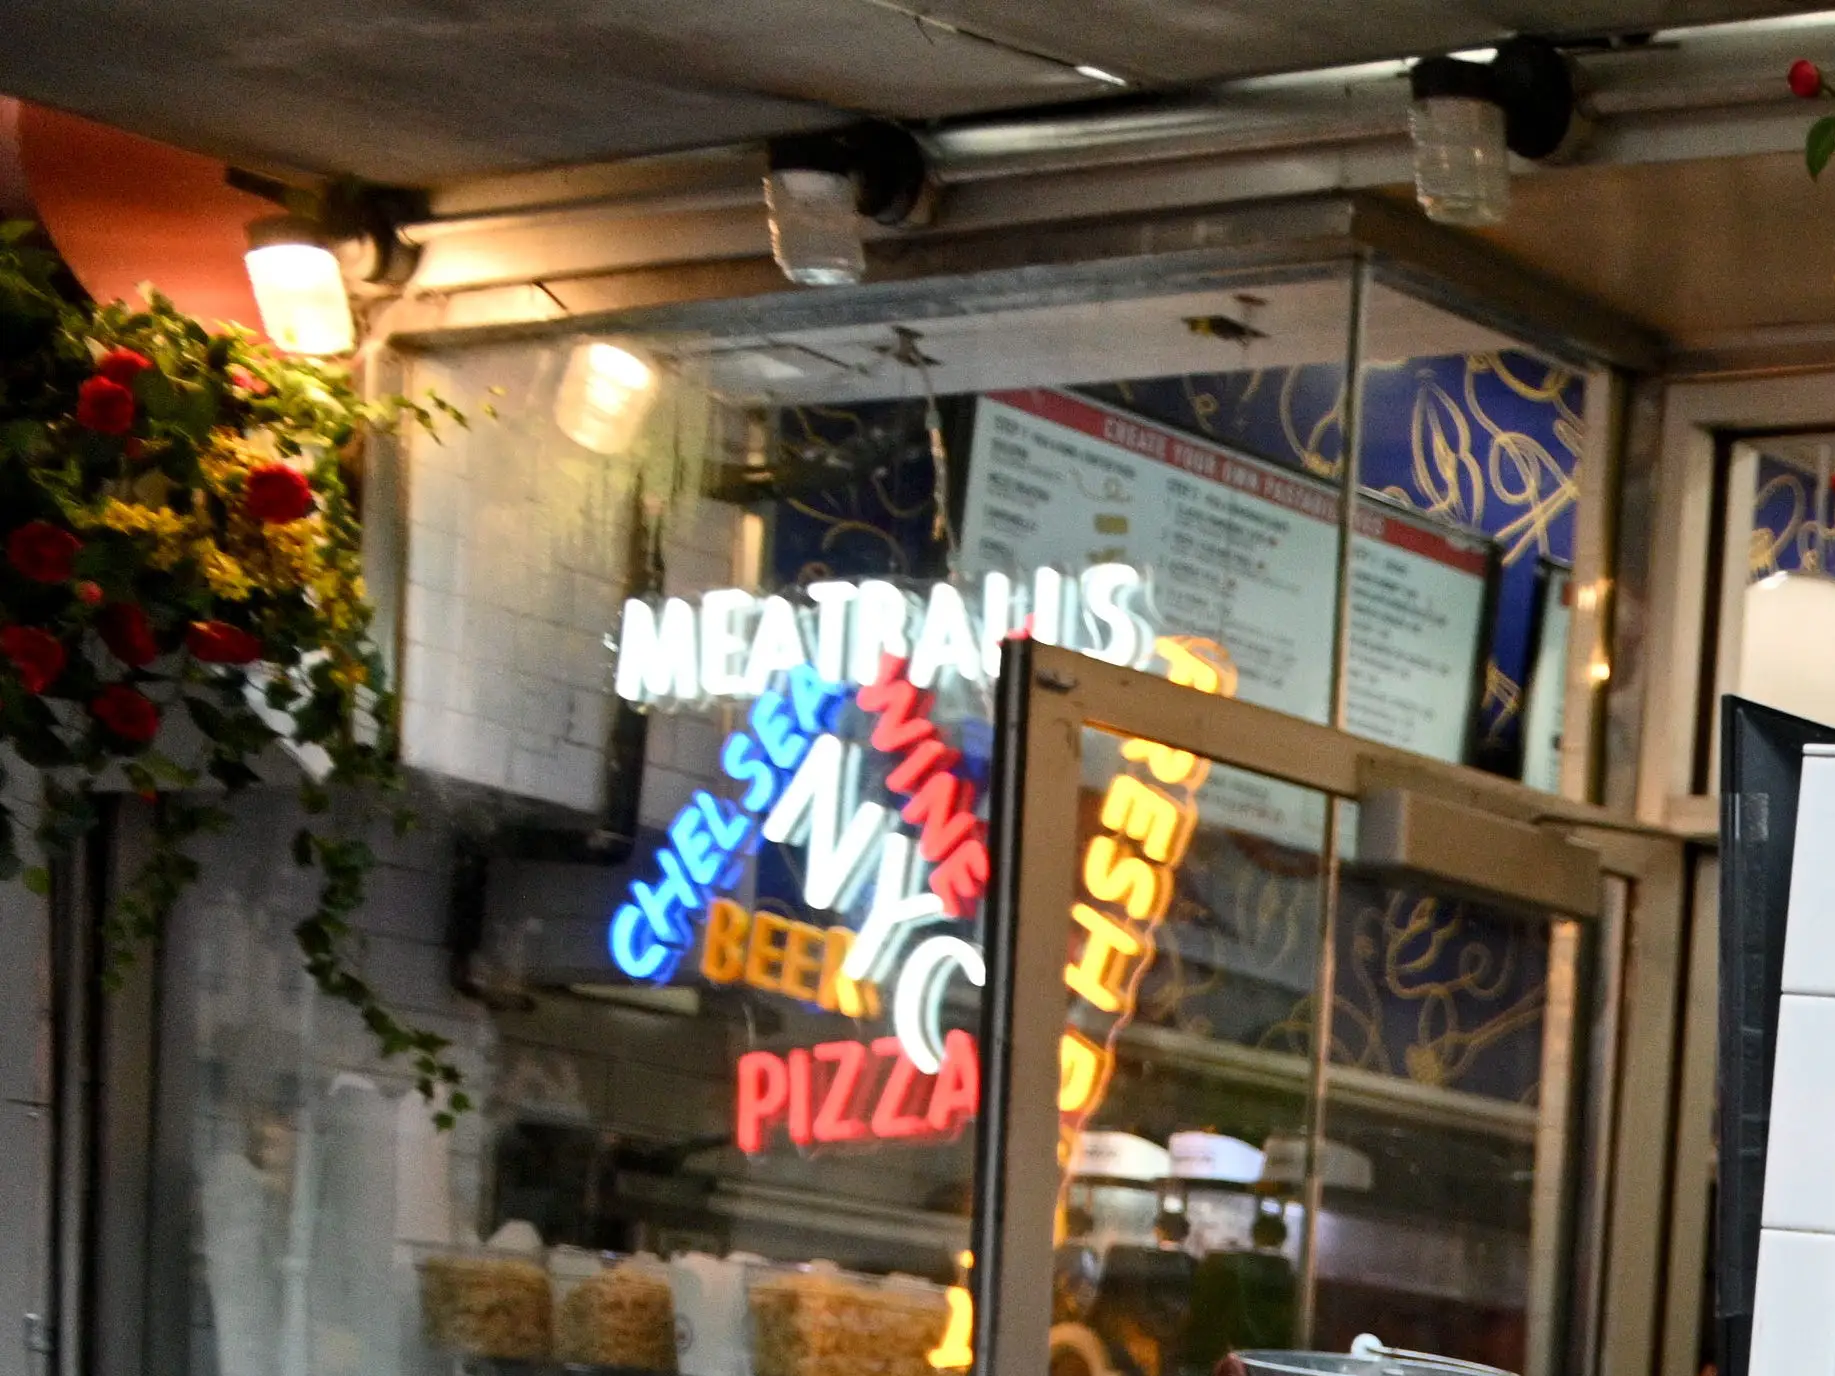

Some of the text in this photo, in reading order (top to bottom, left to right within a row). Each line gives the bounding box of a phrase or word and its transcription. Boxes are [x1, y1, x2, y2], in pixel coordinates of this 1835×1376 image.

[609, 660, 847, 980] CHELSEA
[761, 733, 988, 1074] NYC
[855, 652, 992, 918] WINE
[736, 1030, 982, 1154] PIZZA
